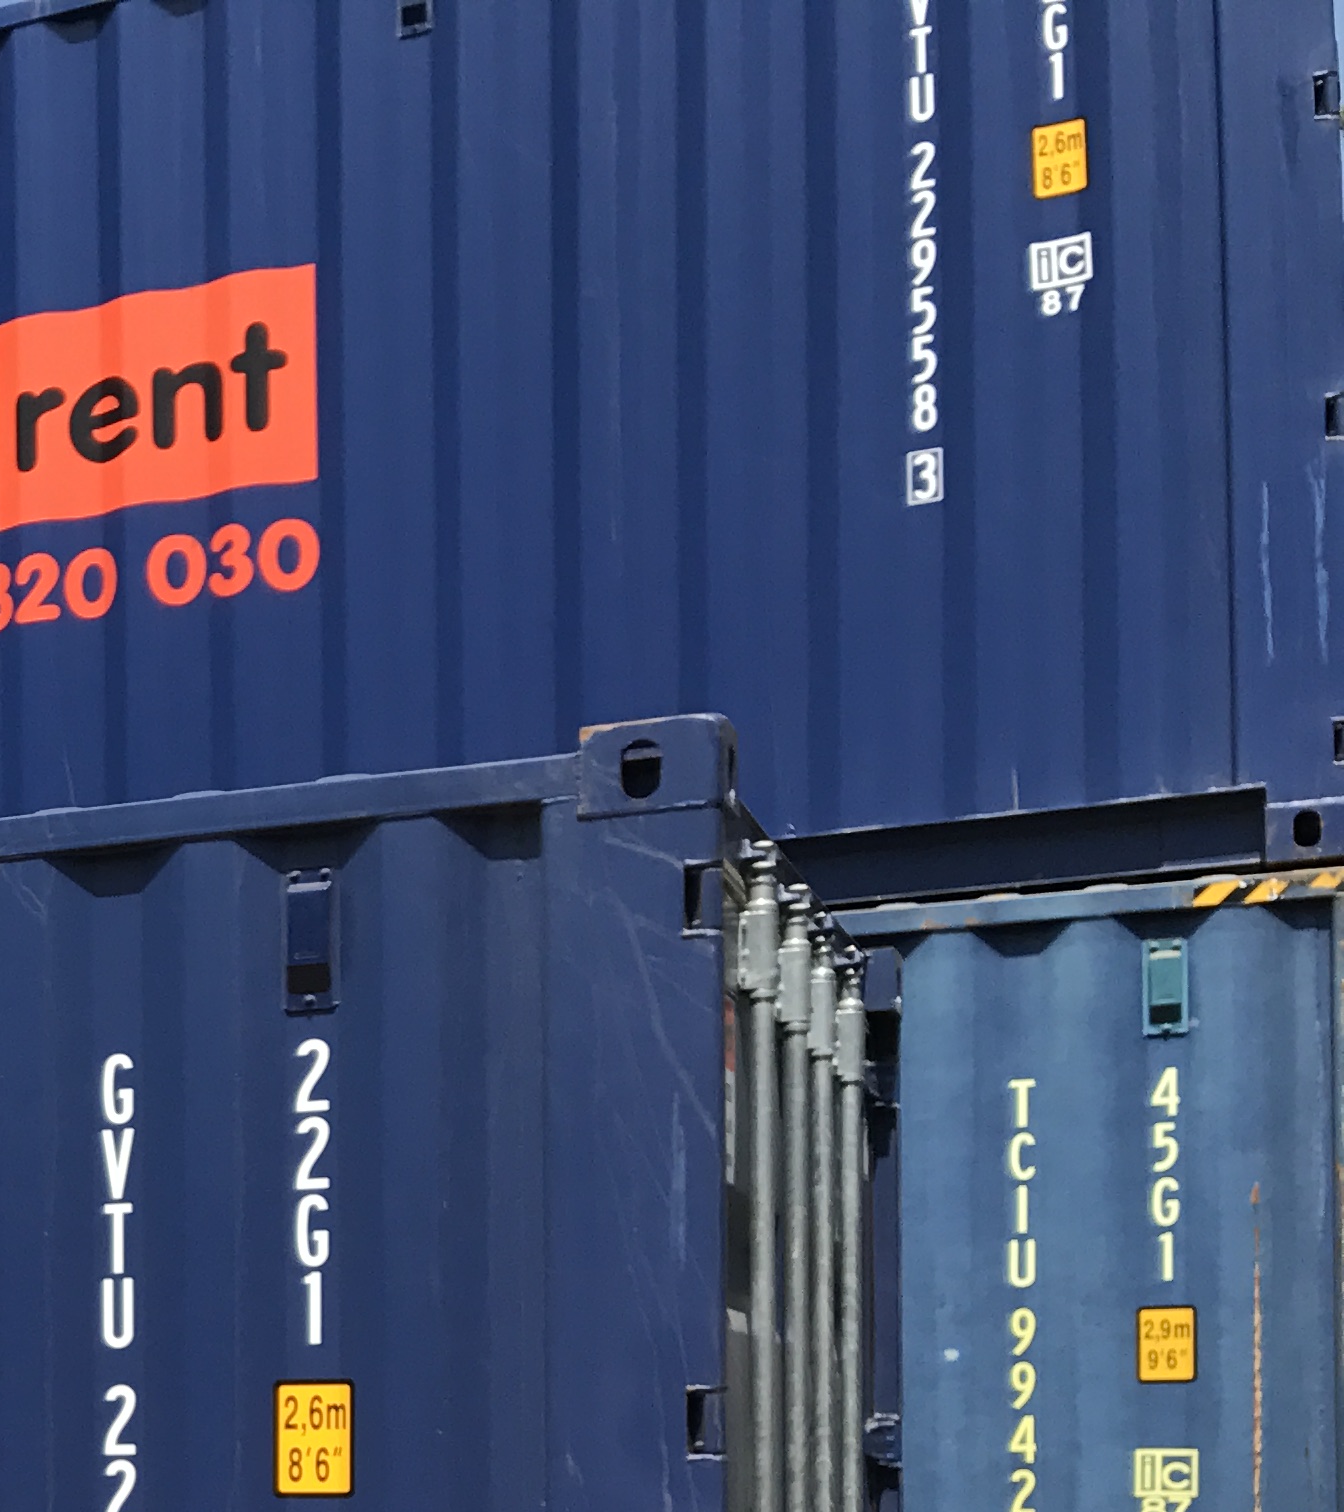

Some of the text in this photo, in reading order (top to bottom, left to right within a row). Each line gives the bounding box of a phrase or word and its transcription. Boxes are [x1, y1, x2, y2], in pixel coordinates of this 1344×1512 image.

[1042, 0, 1069, 100] G1
[1038, 131, 1083, 157] 2,6m
[910, 141, 938, 432] 229558
[1042, 284, 1085, 316] 87
[15, 321, 289, 473] rent
[915, 453, 937, 499] 3
[146, 518, 320, 607] 030
[101, 1053, 135, 1349] GVTU
[294, 1038, 330, 1345] 22G1
[1007, 1078, 1037, 1288] TCIU
[1150, 1066, 1181, 1282] 45G1
[283, 1395, 347, 1438] 2,6m
